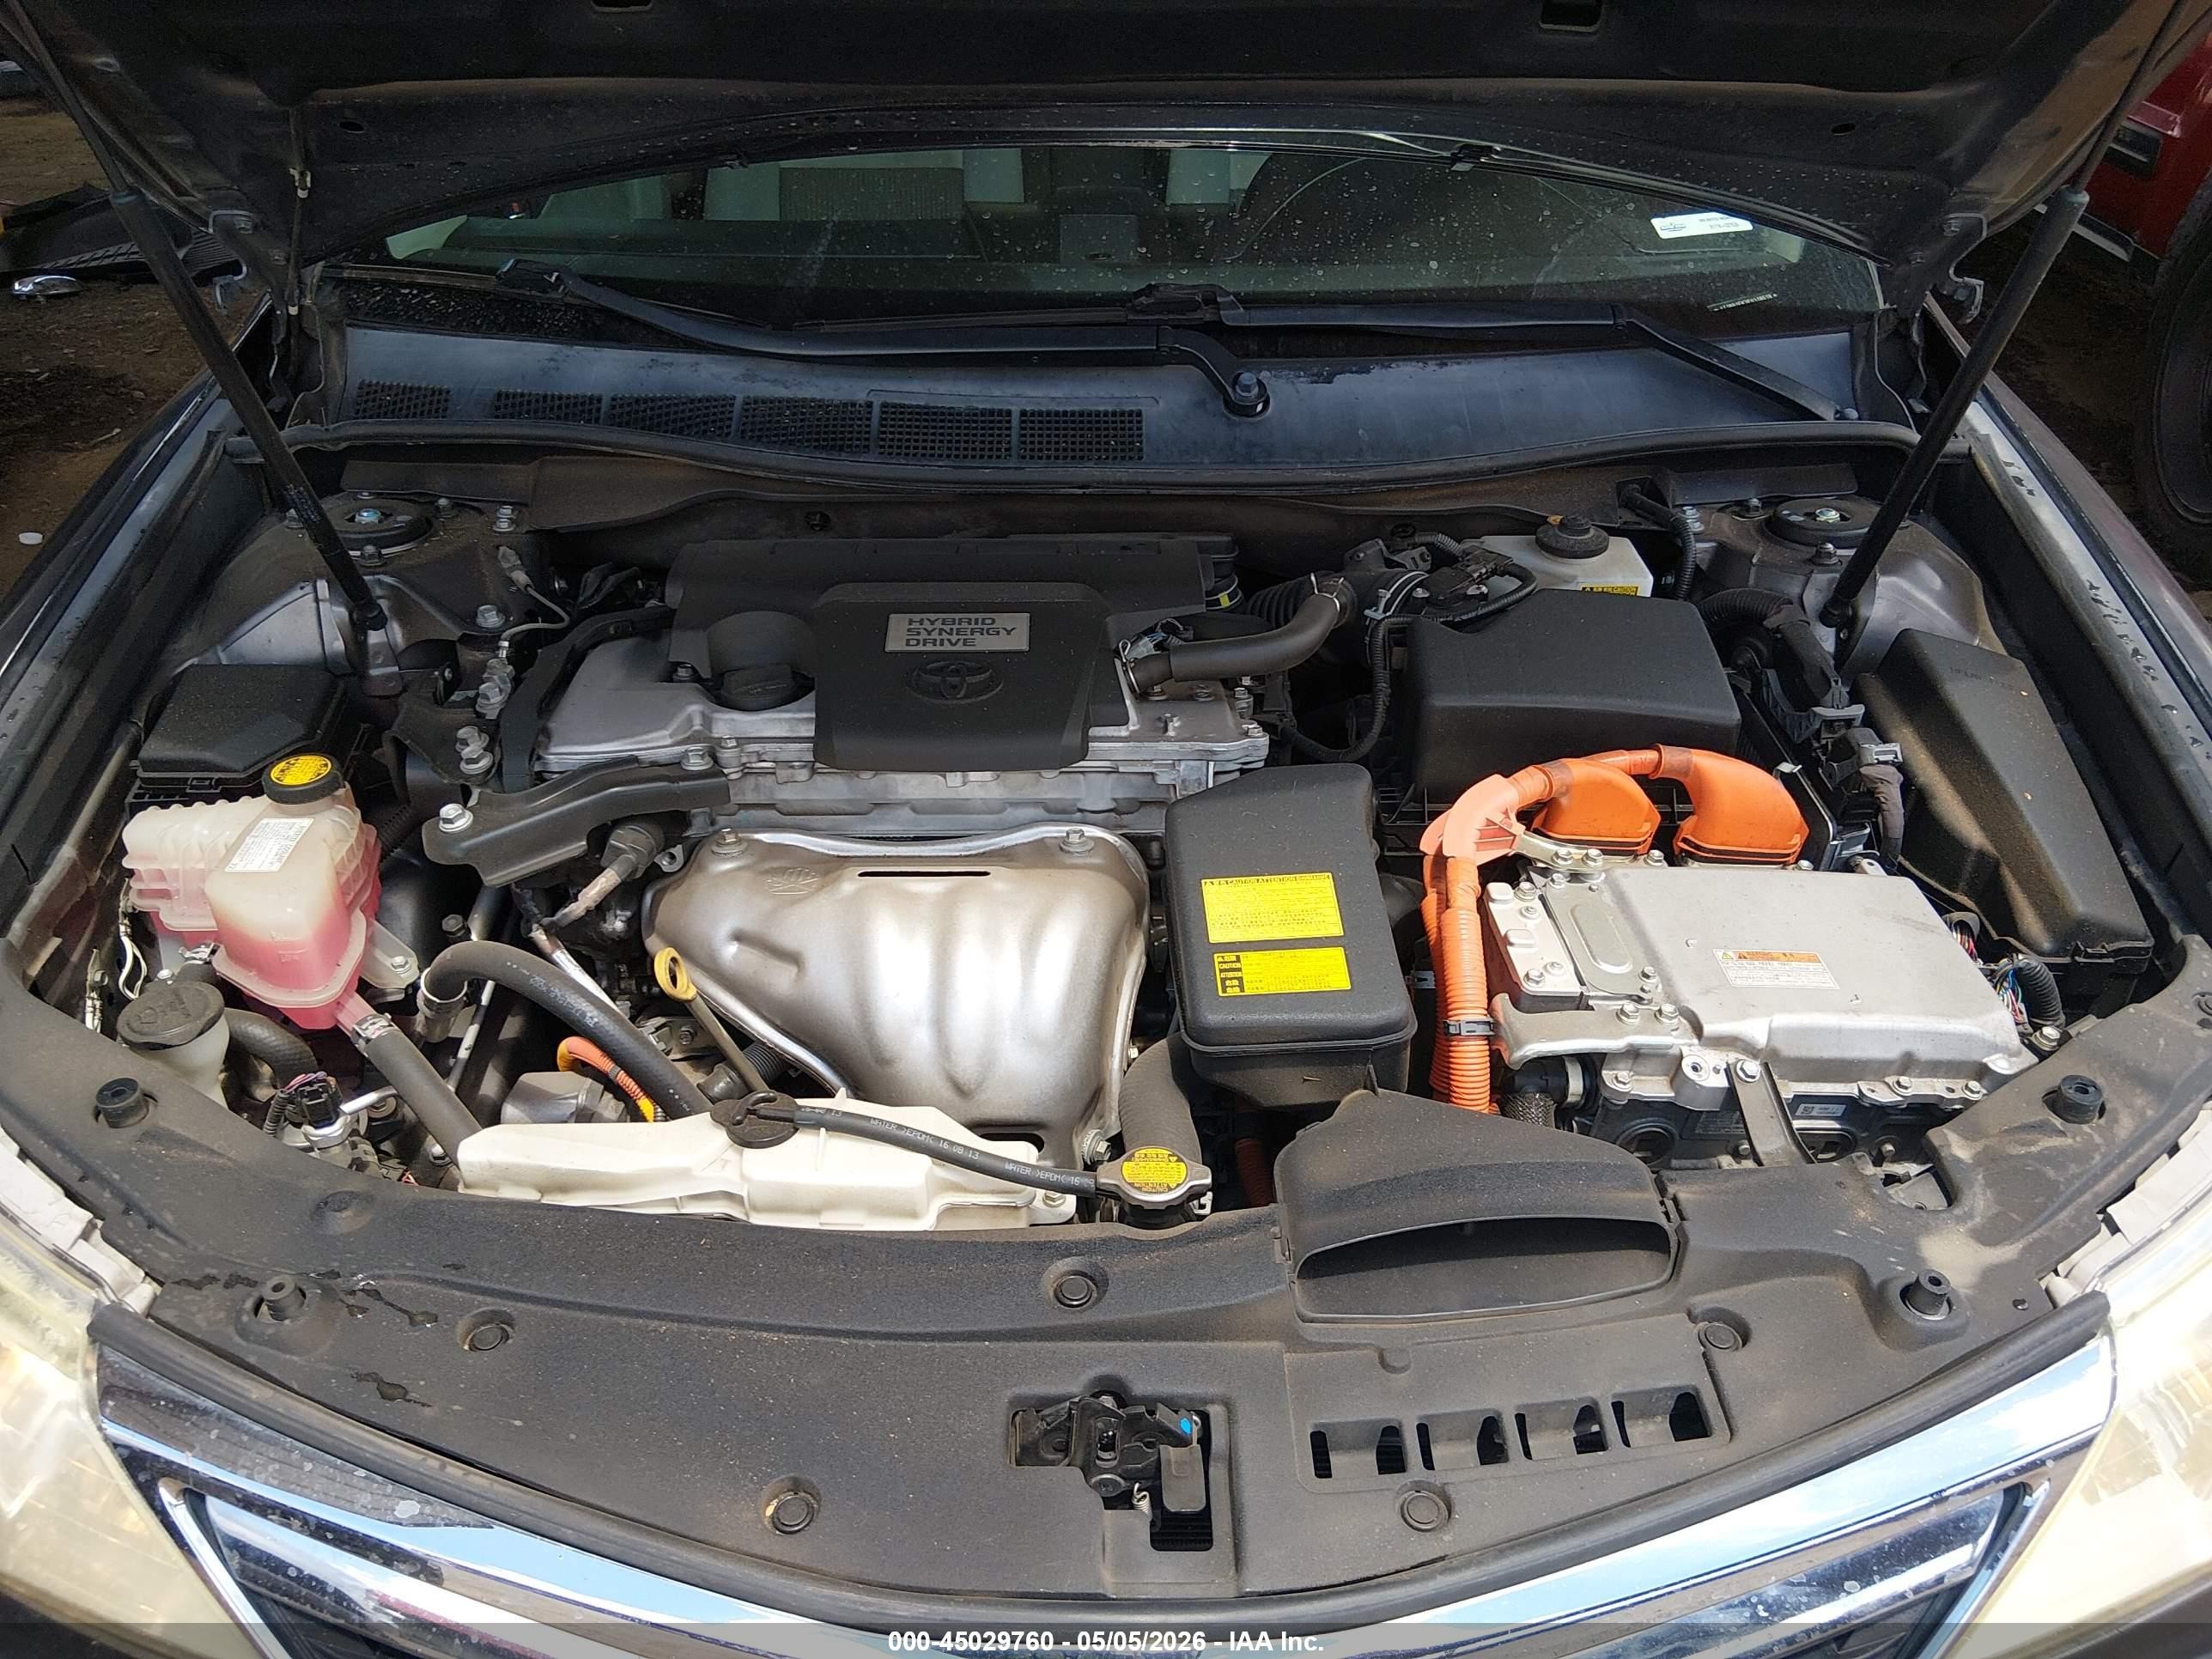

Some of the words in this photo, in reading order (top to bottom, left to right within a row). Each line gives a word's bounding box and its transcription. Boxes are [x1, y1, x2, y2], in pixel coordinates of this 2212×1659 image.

[908, 617, 995, 626] HYBRID
[905, 638, 976, 647] DRIVE
[870, 1118, 897, 1131] WATER
[939, 1139, 949, 1150] 16
[953, 1145, 963, 1155] 08
[968, 1150, 980, 1160] 13
[1005, 1163, 1031, 1176] WATER
[1071, 1176, 1079, 1186] 16
